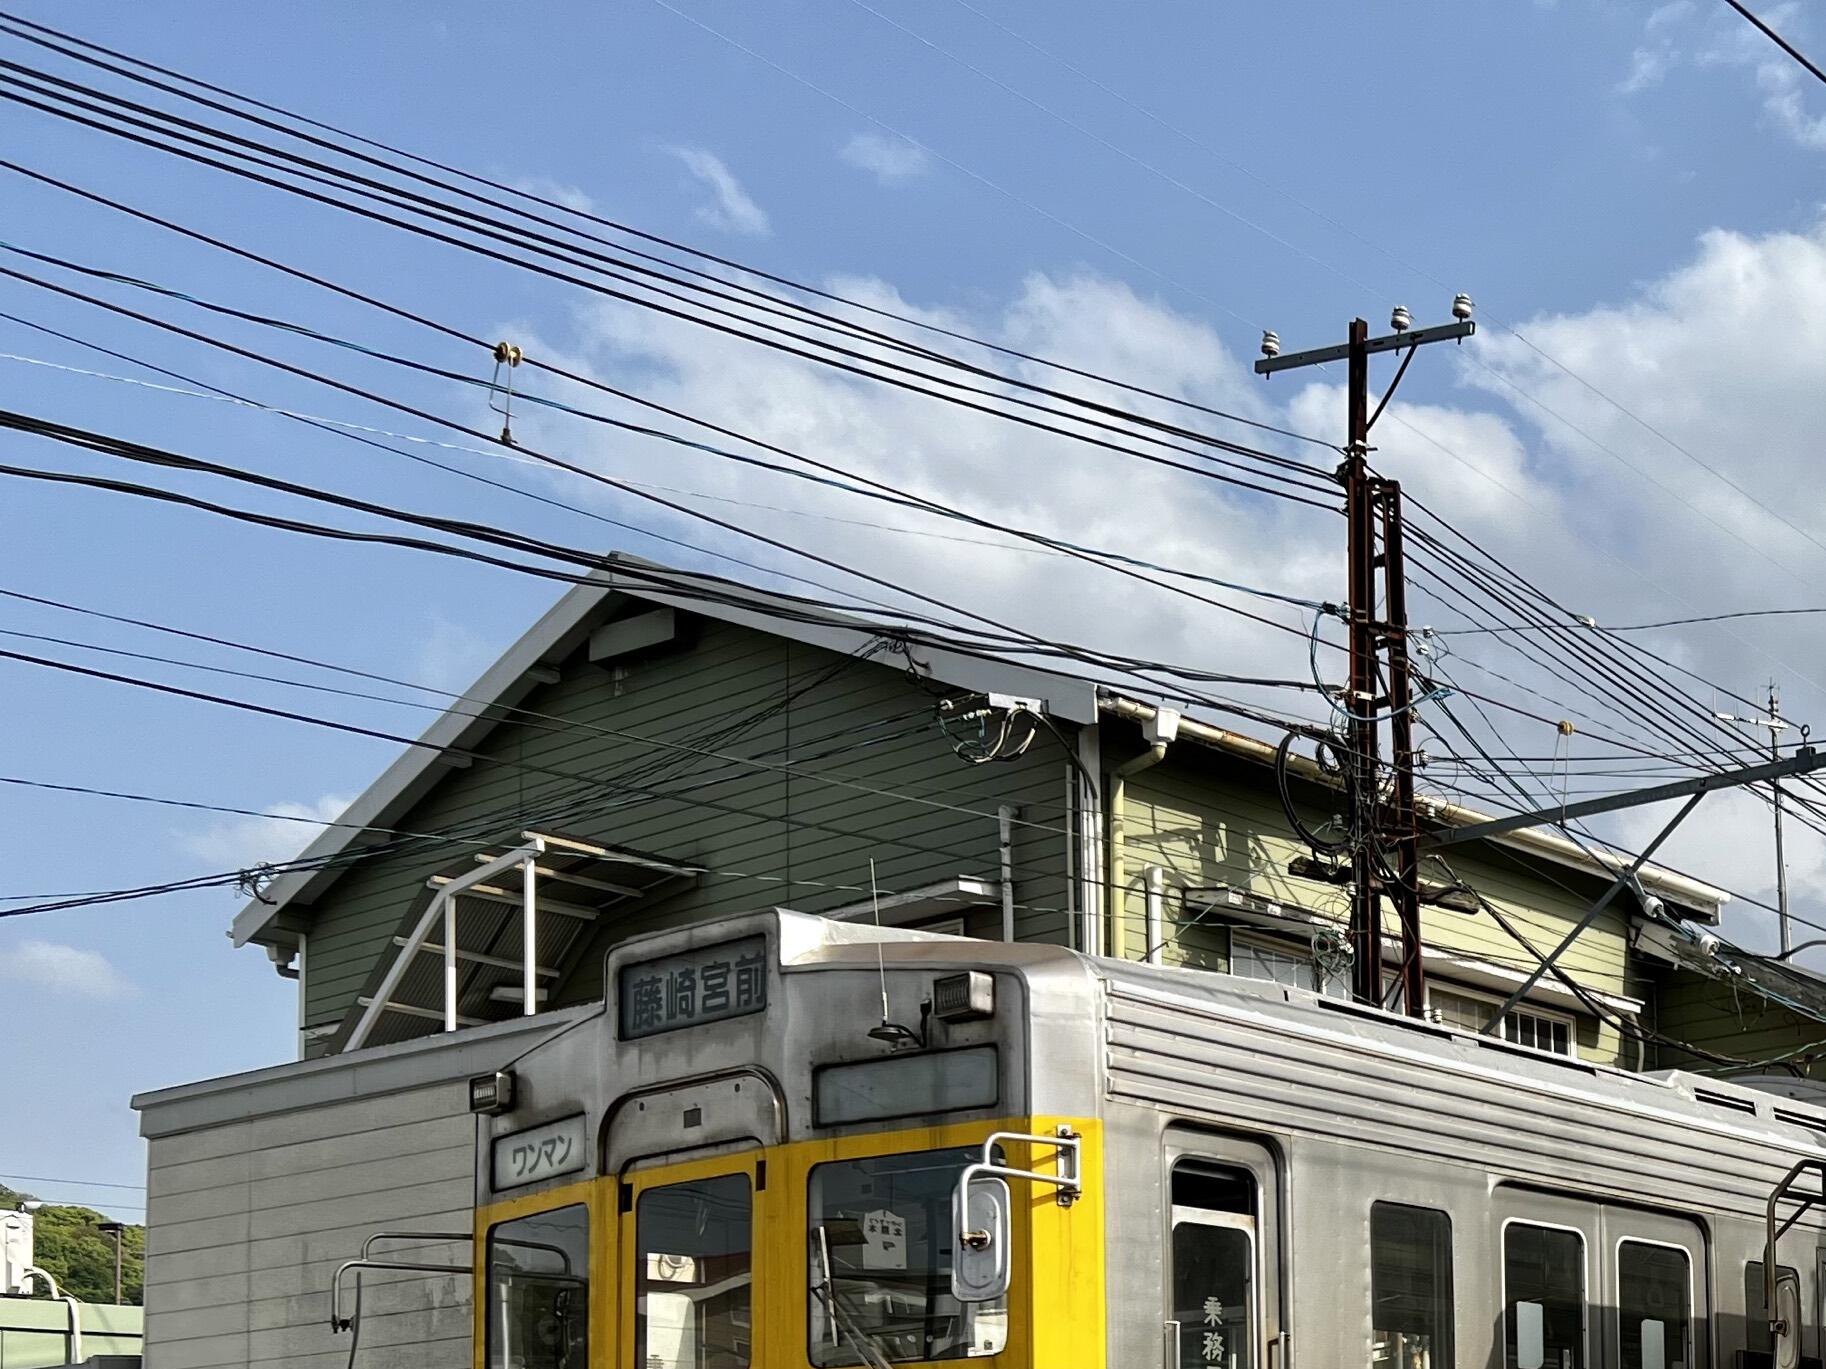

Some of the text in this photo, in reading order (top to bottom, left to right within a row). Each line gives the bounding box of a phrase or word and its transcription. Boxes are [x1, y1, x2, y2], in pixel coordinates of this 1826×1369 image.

[632, 953, 767, 1030] 藤崎宮前
[512, 1136, 572, 1177] ワンマン
